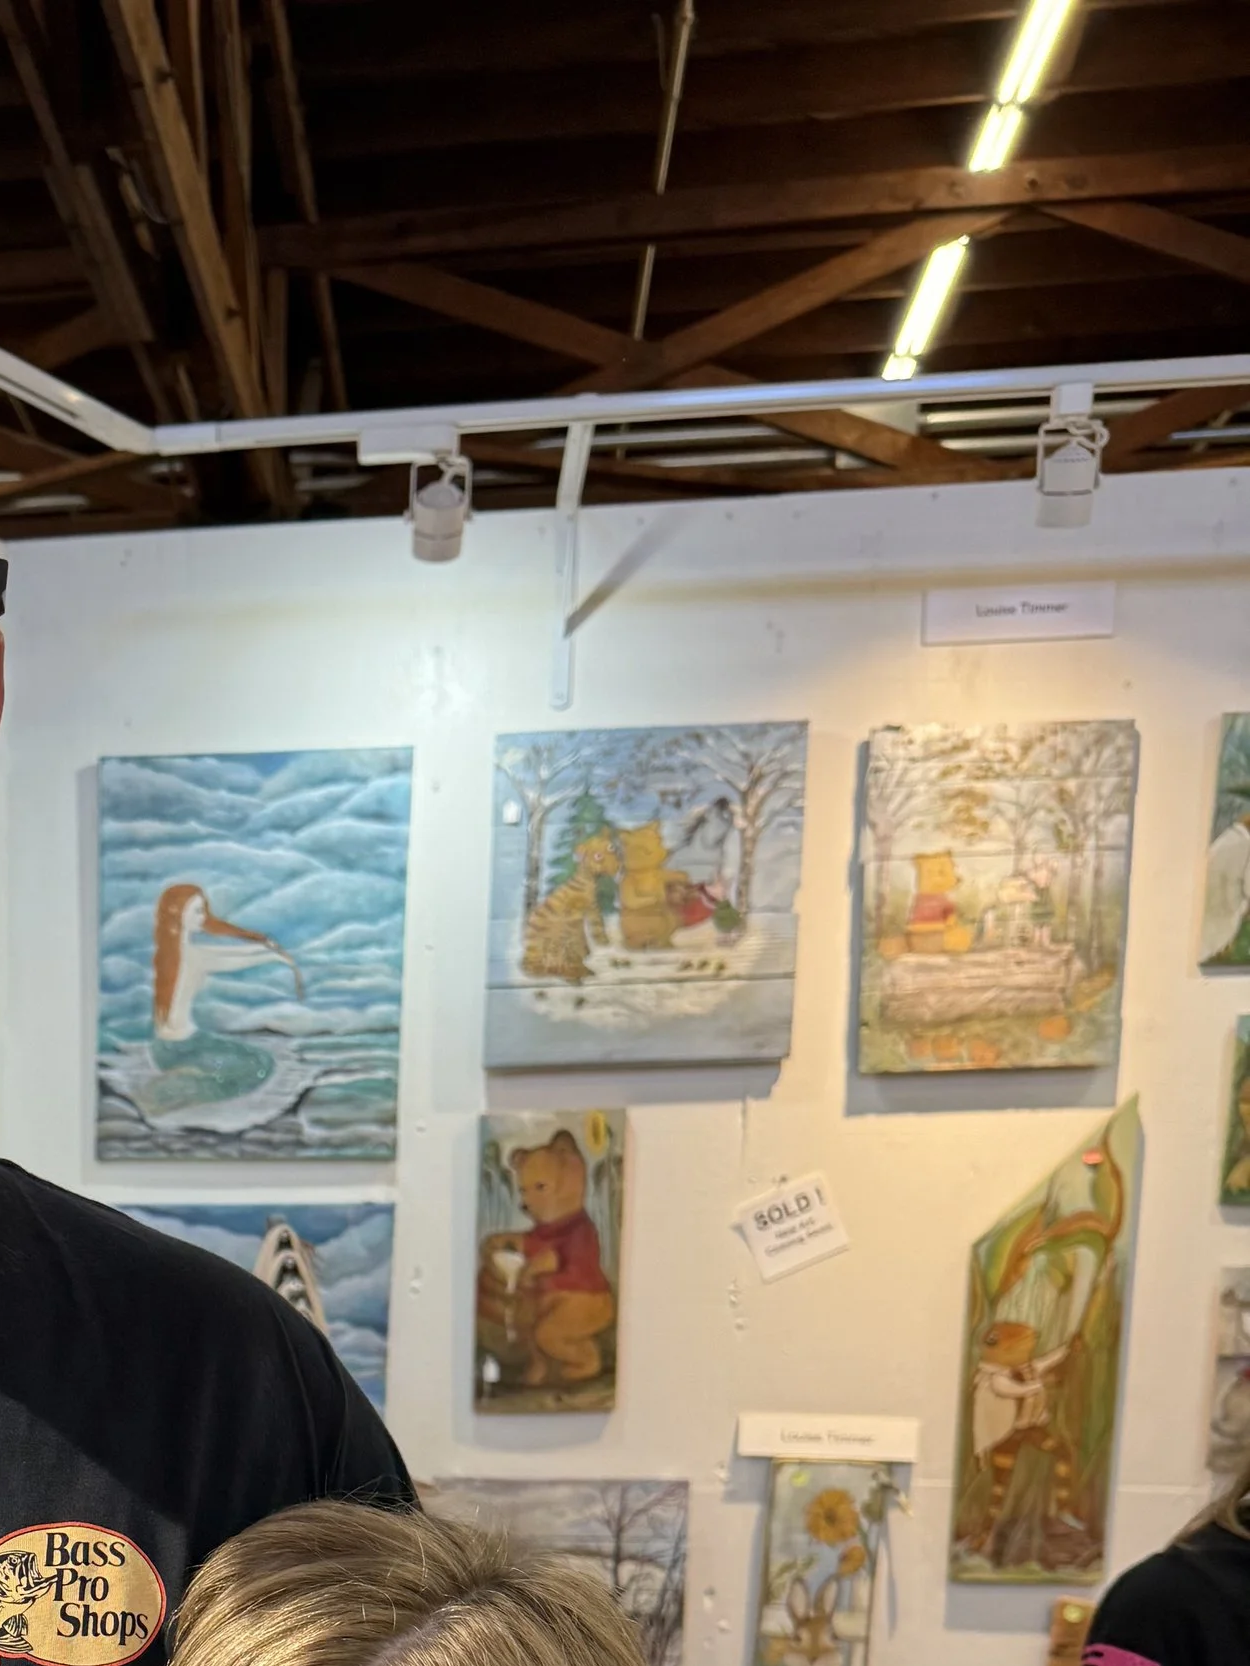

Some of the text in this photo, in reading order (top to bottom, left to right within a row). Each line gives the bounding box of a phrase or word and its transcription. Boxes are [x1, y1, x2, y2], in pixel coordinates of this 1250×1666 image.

[44, 1532, 126, 1567] Bass
[53, 1568, 109, 1602] Pro
[57, 1602, 148, 1646] Shops
